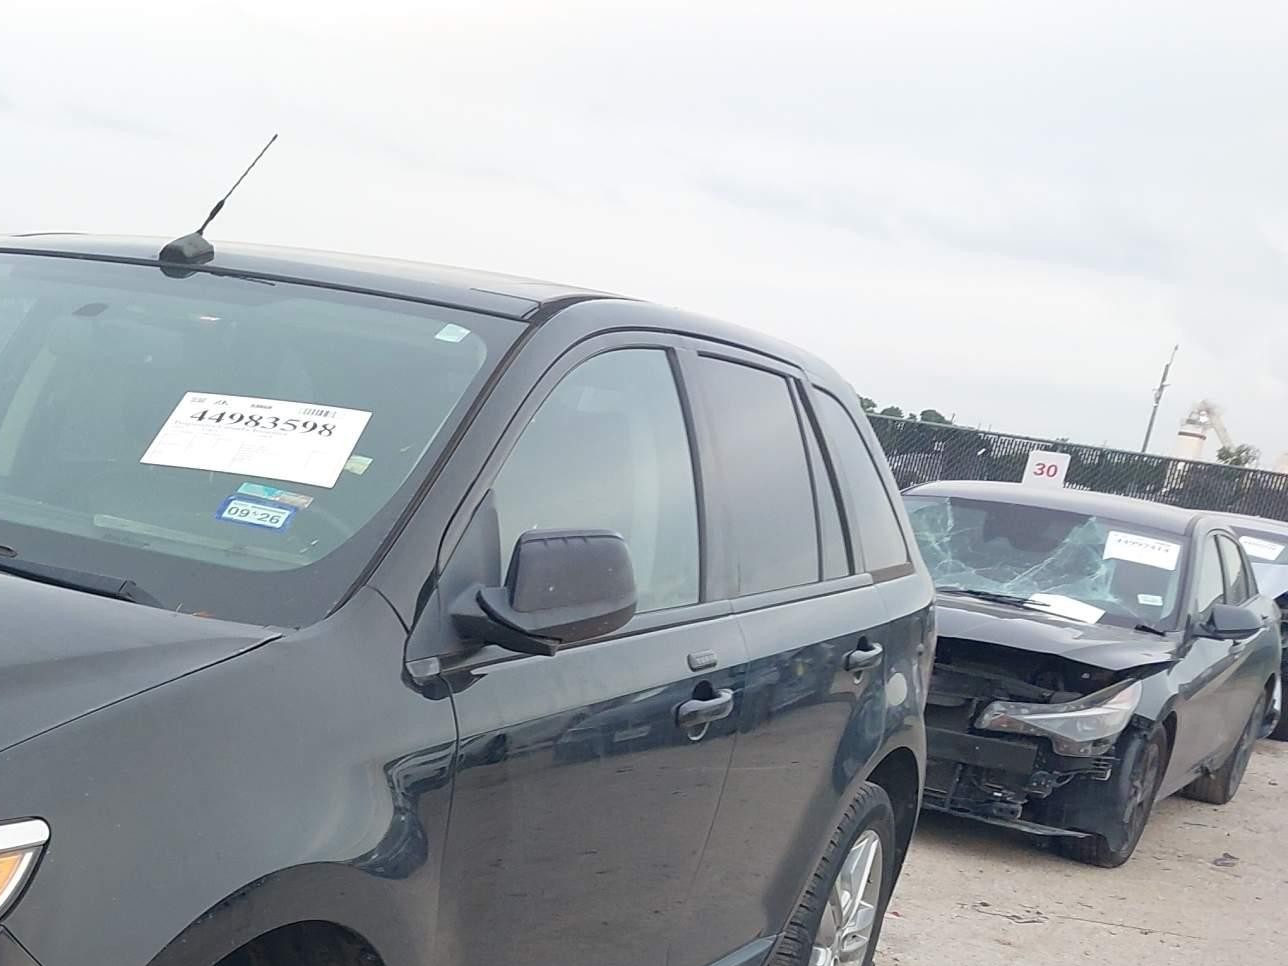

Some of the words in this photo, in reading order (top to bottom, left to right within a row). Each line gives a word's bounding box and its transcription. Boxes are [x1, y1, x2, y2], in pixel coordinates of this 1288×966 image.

[189, 409, 337, 437] 44983598
[1033, 462, 1058, 478] 30
[227, 506, 250, 518] 09
[257, 512, 282, 525] 26
